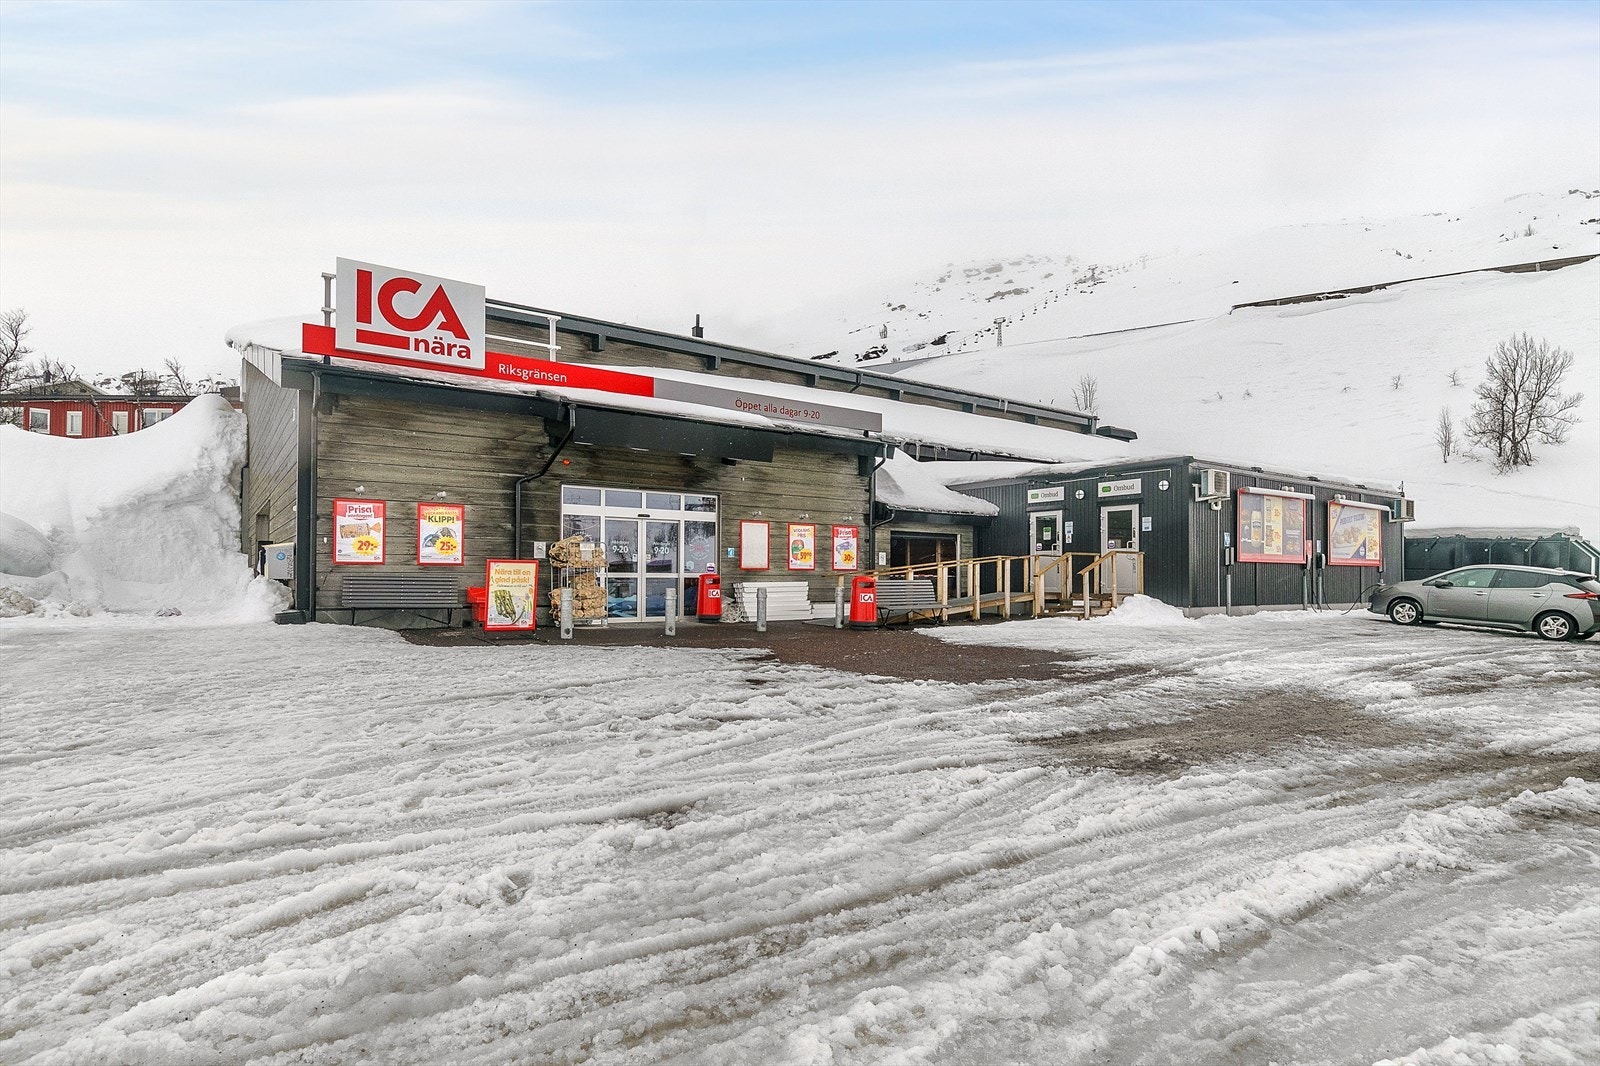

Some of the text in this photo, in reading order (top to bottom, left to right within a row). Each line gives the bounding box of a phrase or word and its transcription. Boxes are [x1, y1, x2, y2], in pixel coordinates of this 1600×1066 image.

[356, 268, 471, 341] ICA
[413, 335, 472, 360] nära
[498, 363, 568, 384] Riksgränsen
[735, 397, 821, 420] Öppet alla dagar 9-20
[348, 505, 372, 514] Prisa
[428, 515, 455, 523] KLIPP!
[612, 546, 629, 554] 9-20
[654, 546, 670, 555] 9-20
[860, 594, 873, 602] ICA
